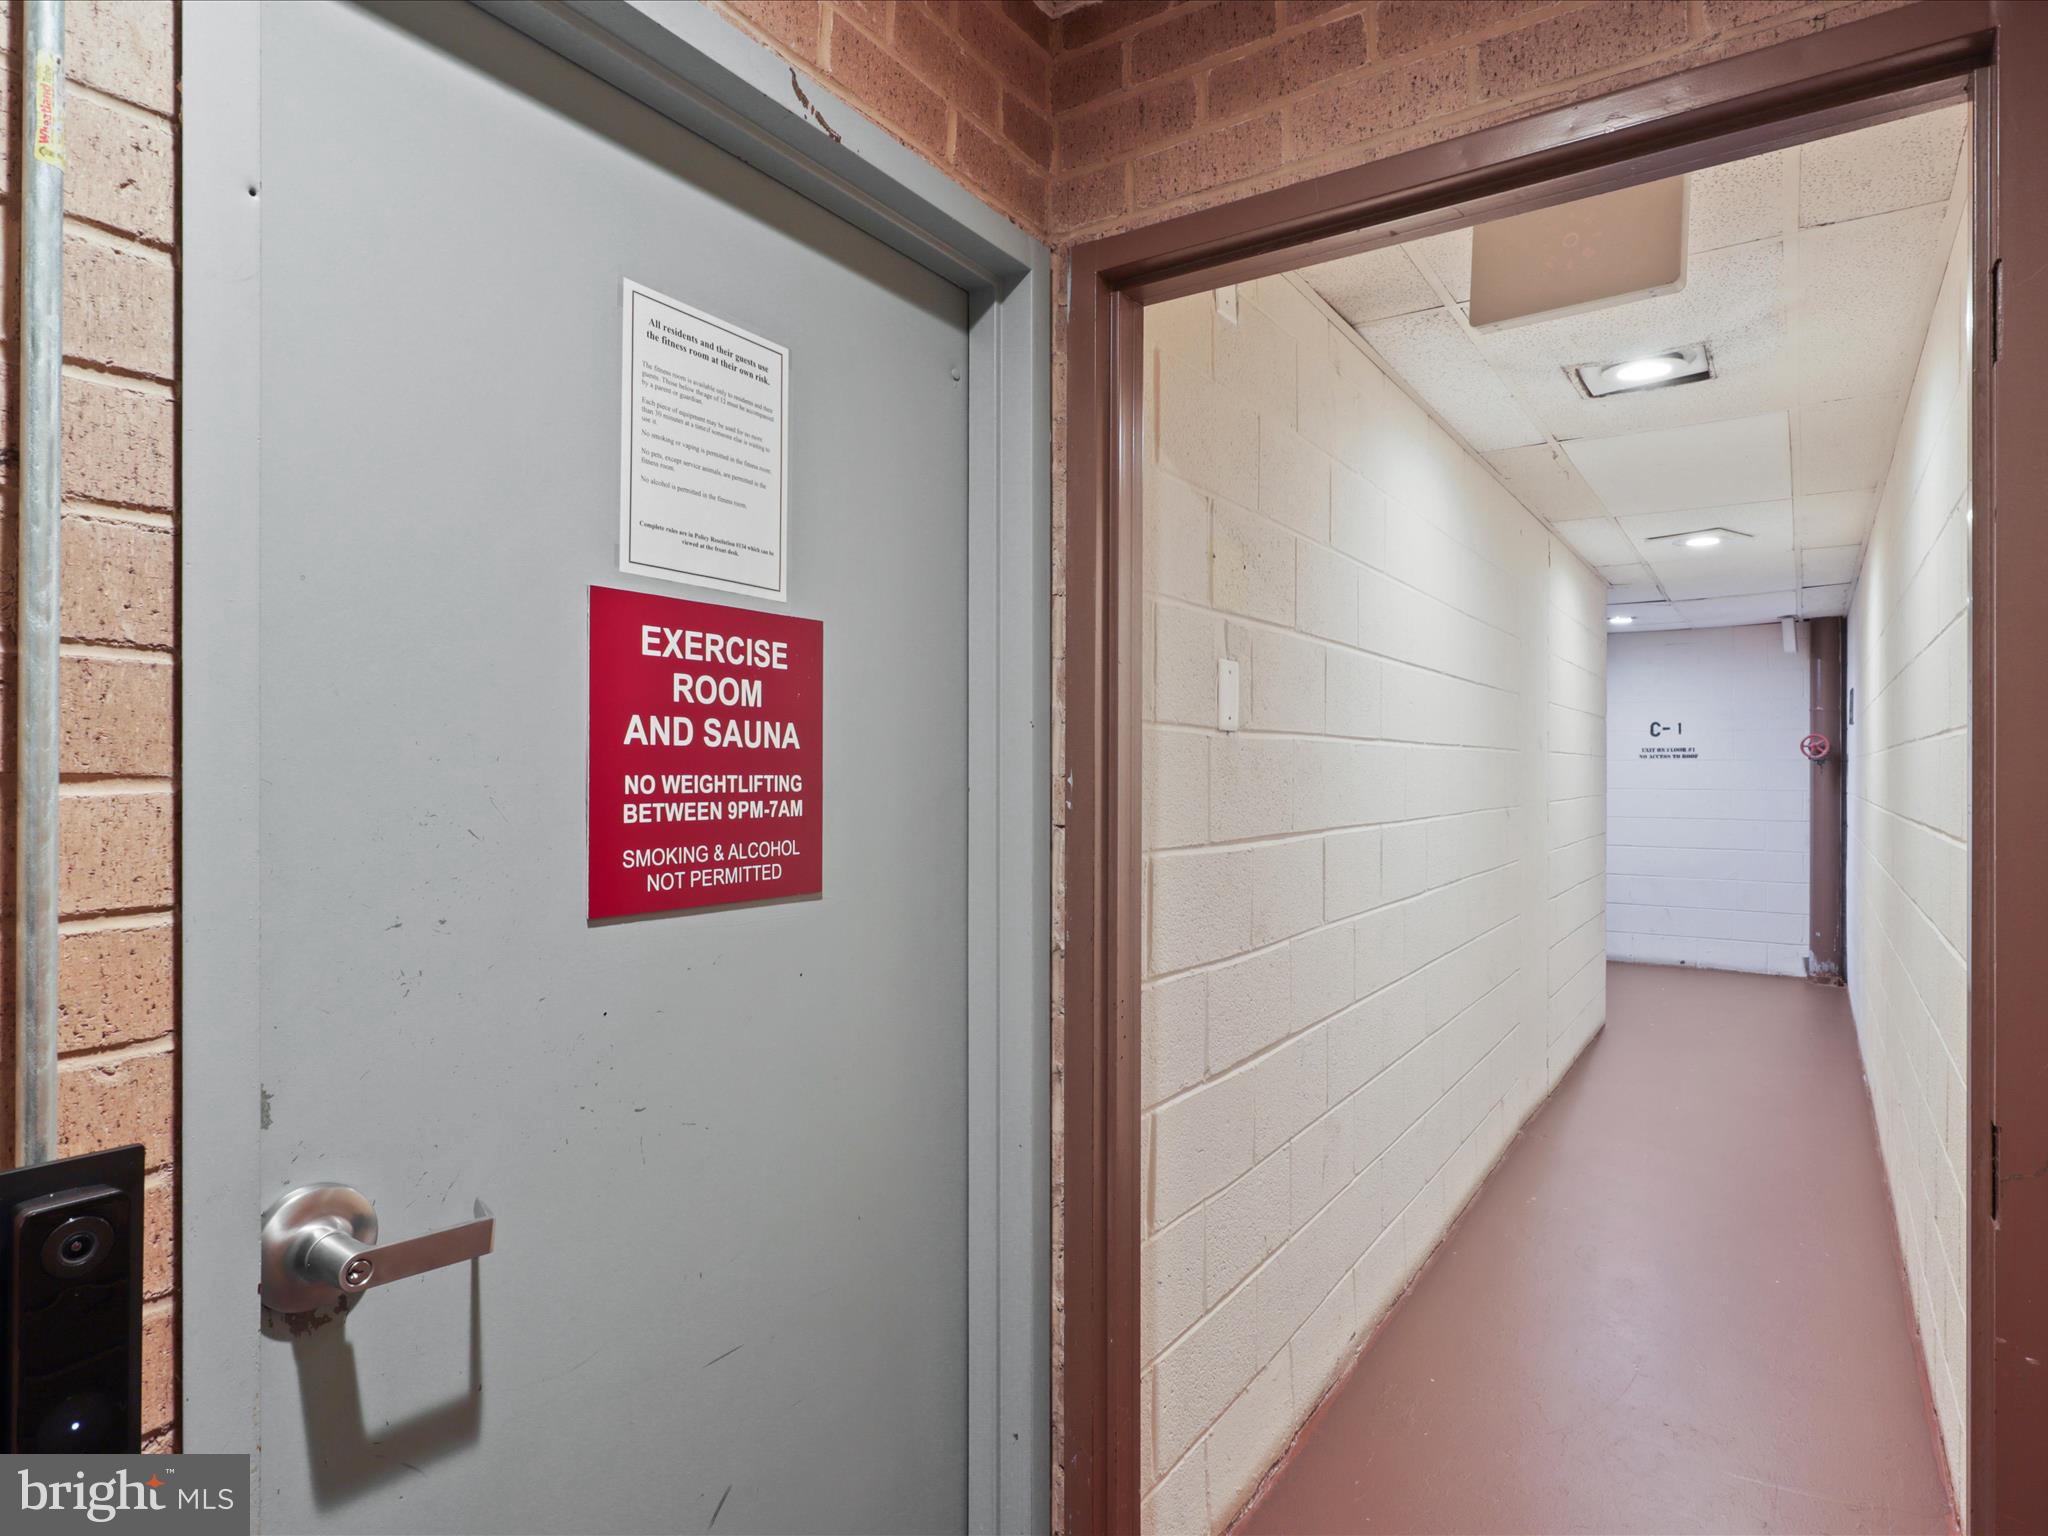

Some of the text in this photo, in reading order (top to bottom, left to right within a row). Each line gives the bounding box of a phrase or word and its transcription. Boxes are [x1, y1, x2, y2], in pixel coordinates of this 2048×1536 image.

[646, 330, 771, 386] the fitness room at their own risk.
[649, 318, 769, 373] All residents and their guests use
[642, 360, 652, 370] The
[642, 378, 648, 388] by
[654, 384, 672, 394] parent
[662, 377, 678, 388] Those
[679, 382, 694, 393] below
[642, 396, 656, 406] Each
[656, 402, 671, 412] piece
[706, 418, 716, 427] may
[641, 428, 650, 438] No
[652, 433, 674, 446] smoking
[682, 442, 700, 454] vaping
[706, 450, 730, 462] permitted
[641, 456, 659, 468] fitness
[641, 447, 650, 456] No
[664, 455, 682, 465] except
[683, 460, 702, 470] service
[732, 474, 754, 486] permitted
[640, 474, 650, 484] No
[650, 478, 671, 488] alcohol
[677, 486, 702, 497] permitted
[717, 496, 734, 505] fitness
[639, 520, 665, 532] Complete
[666, 526, 678, 534] rules
[694, 532, 710, 542] Policy
[710, 536, 736, 548] Resolution
[748, 545, 760, 554] which
[681, 540, 699, 548] viewed
[714, 546, 727, 554] front
[642, 624, 788, 670] EXERCISE
[672, 673, 762, 708] ROOM
[623, 714, 800, 750] AND SAUNA
[624, 774, 802, 796] NO WEIGHTLIFTING
[623, 800, 803, 824] BETWEEN 9PM-7AM
[622, 840, 800, 869] SMOKING & ALCOHOL
[647, 863, 782, 892] NOT PERMITTED
